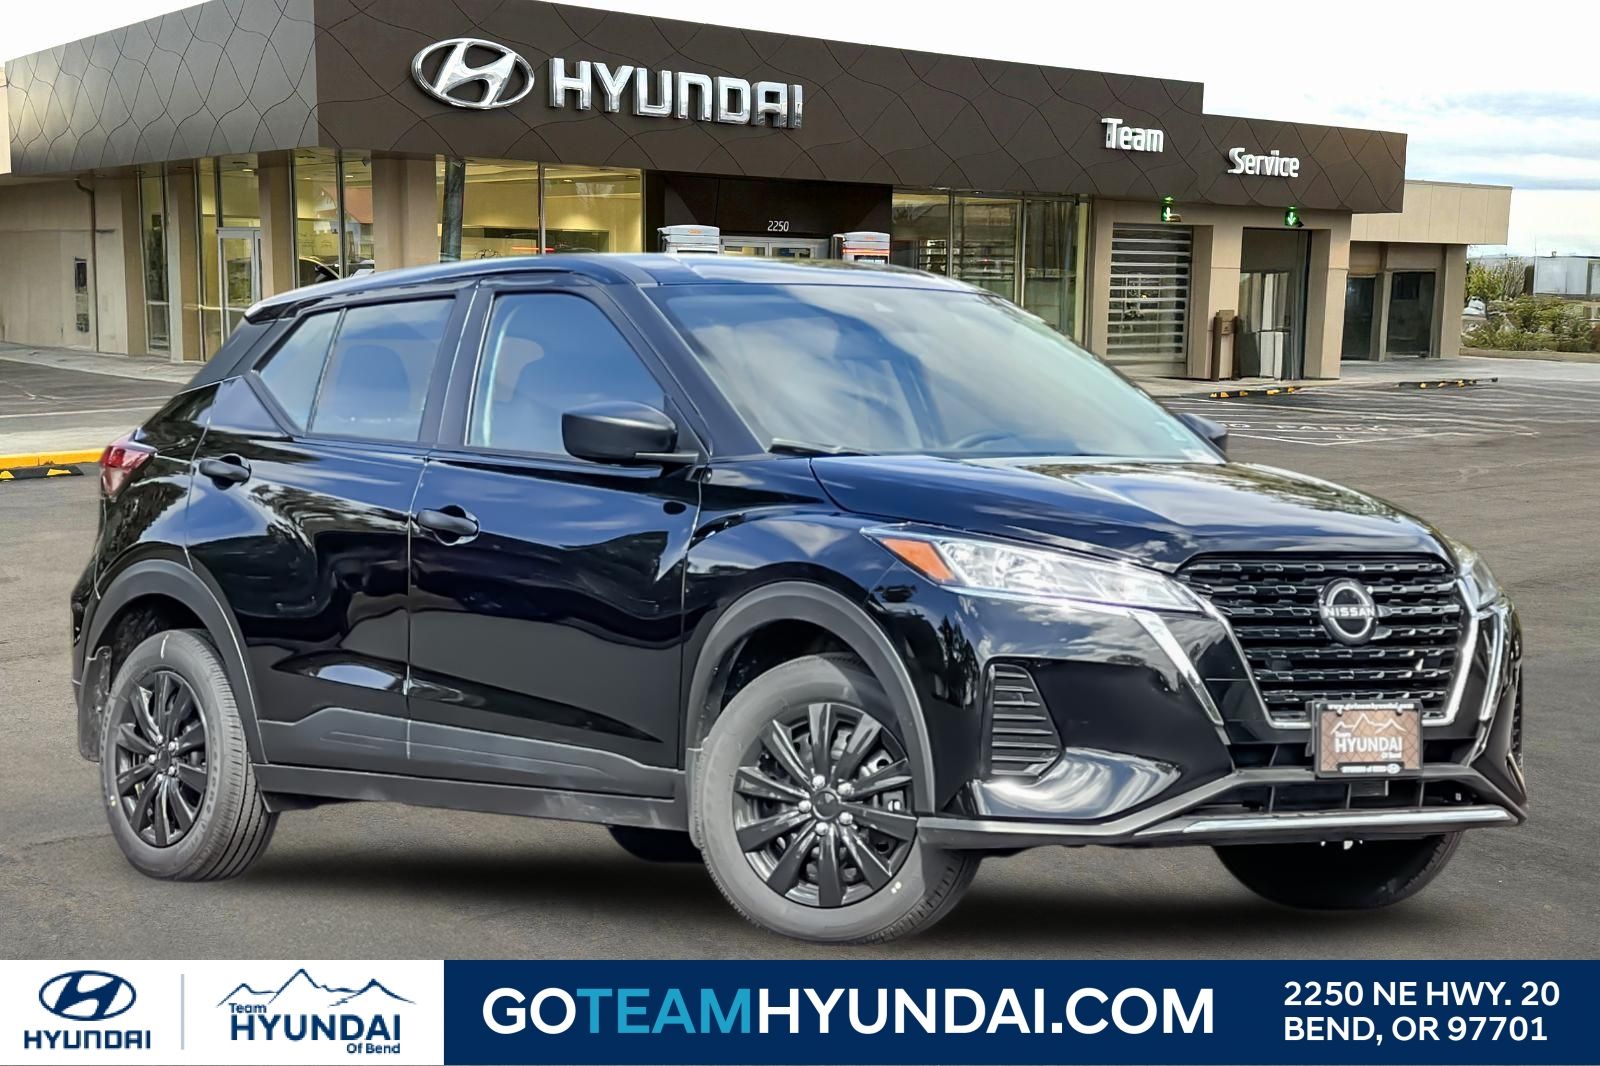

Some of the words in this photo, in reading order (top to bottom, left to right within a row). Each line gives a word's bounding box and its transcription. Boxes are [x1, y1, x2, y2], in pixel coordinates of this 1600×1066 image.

[549, 57, 803, 129] HYUNDAI
[1101, 117, 1164, 153] Team
[1227, 147, 1300, 178] Service
[767, 220, 790, 232] 2250
[1325, 606, 1376, 617] NISSAN
[1335, 736, 1403, 753] HYUNDAI
